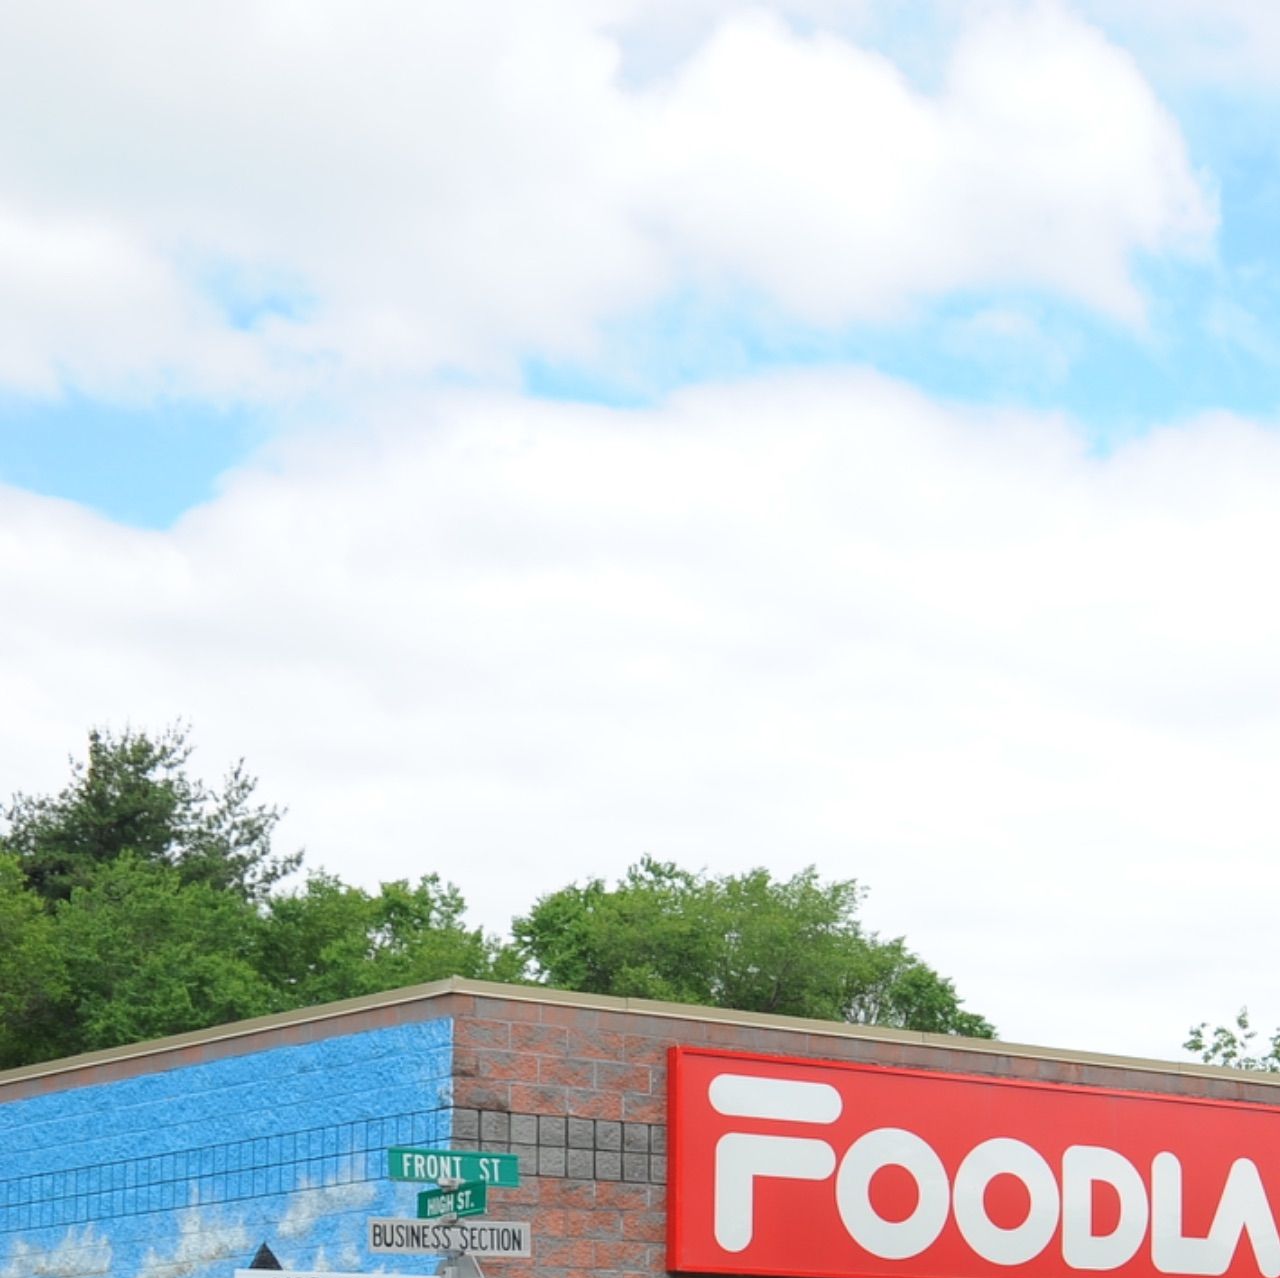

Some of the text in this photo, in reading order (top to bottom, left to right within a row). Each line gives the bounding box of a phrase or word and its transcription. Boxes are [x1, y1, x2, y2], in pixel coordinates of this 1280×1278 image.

[402, 1153, 501, 1183] FRONT ST
[427, 1194, 454, 1216] HIGH
[372, 1224, 522, 1251] BUSINESS SECTION
